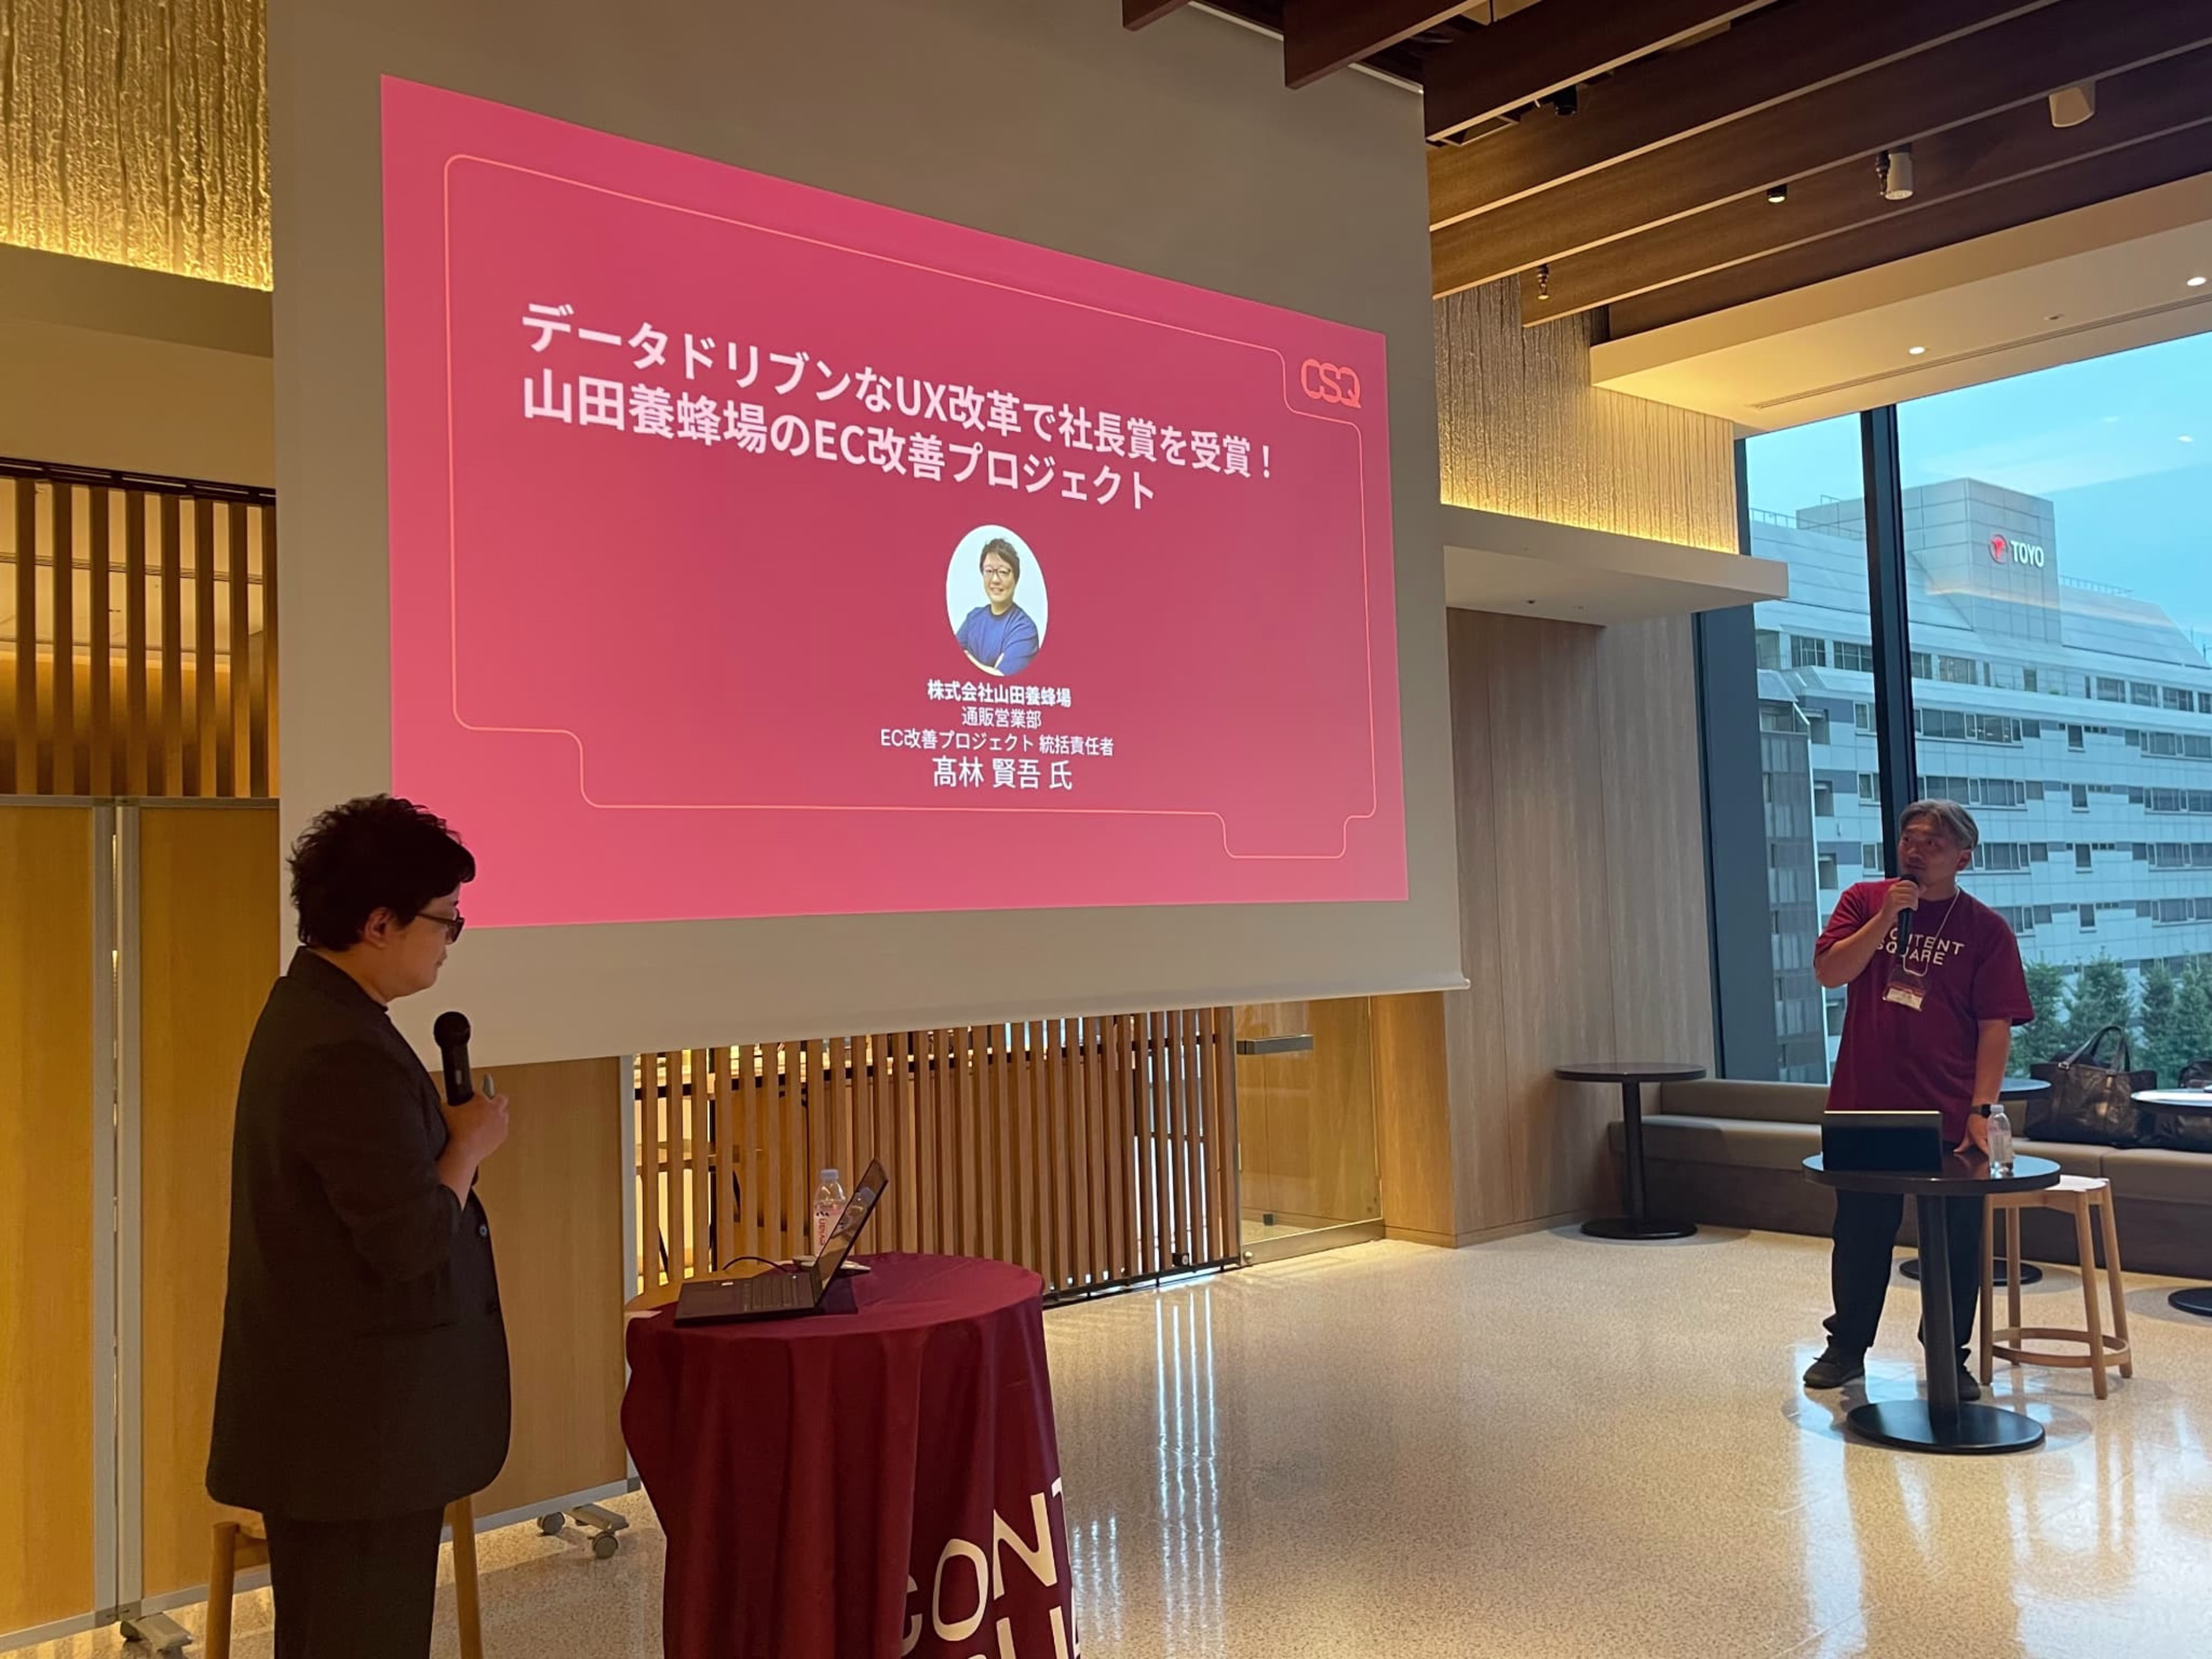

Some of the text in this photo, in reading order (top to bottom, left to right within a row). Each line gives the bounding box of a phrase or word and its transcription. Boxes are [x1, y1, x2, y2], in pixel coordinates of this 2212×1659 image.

[1301, 358, 1362, 408] CSQ
[524, 368, 1154, 509] 山田養蜂場のEC改善プロジェクト
[2010, 540, 2044, 567] TOYO
[927, 679, 1071, 708] 株式会社山田養蜂場
[961, 706, 1041, 729] 通販営業部
[880, 728, 1114, 757] EC改善プロジェクト 統括責任者
[992, 757, 1041, 789] 賢吾
[1048, 760, 1073, 790] 氏
